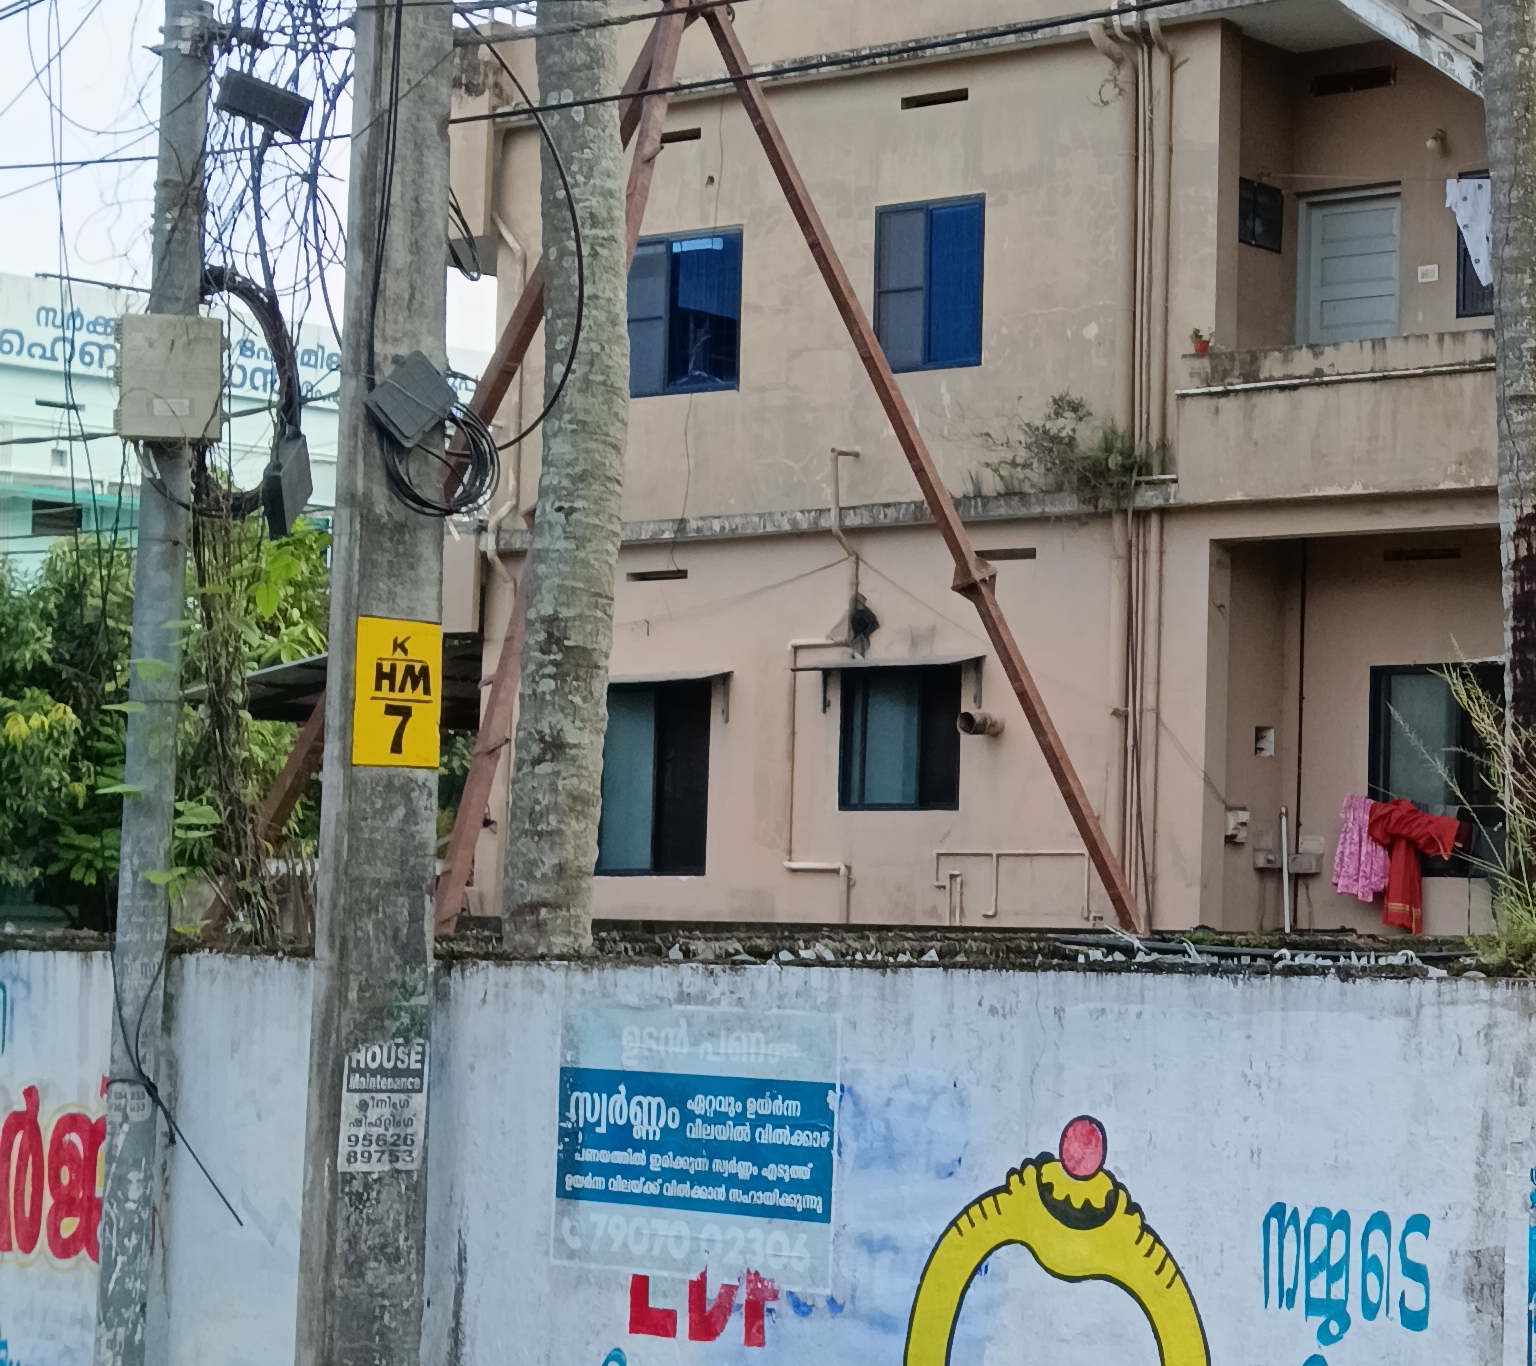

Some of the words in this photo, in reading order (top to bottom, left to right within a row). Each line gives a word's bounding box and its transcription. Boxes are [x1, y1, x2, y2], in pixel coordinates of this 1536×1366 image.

[392, 635, 411, 657] K
[374, 662, 431, 697] HM
[384, 703, 412, 754] 7
[351, 1039, 422, 1069] HOUSE
[686, 1094, 742, 1118] ഏറ്റവും
[347, 1133, 415, 1148] 95626
[686, 1118, 751, 1142] വിലയിൽ
[346, 1149, 415, 1165] 89753
[1262, 1201, 1431, 1346] നമ്മുടെ
